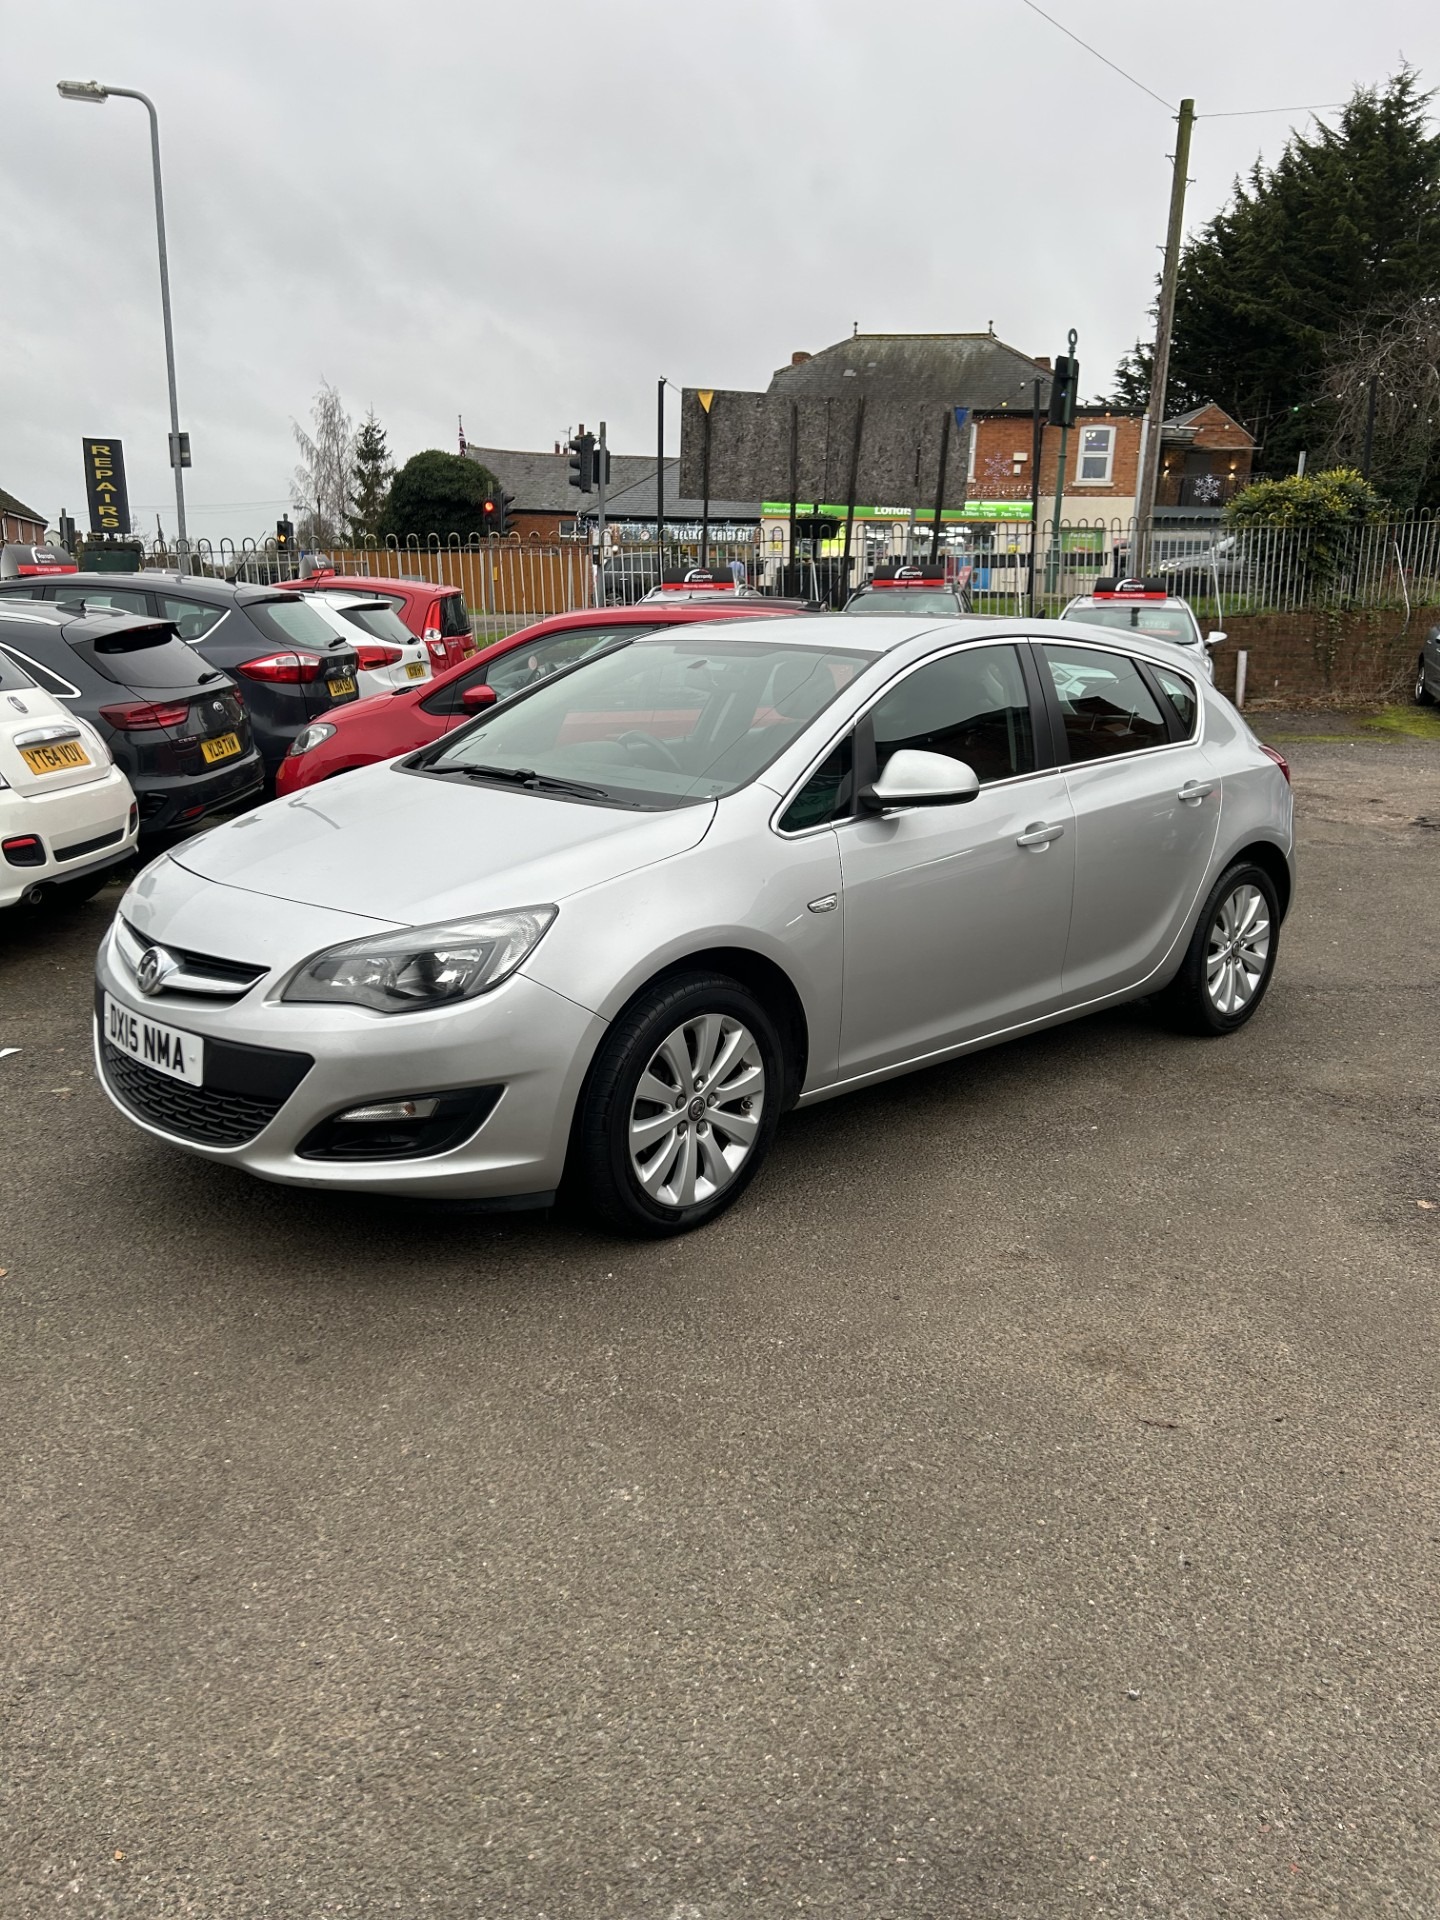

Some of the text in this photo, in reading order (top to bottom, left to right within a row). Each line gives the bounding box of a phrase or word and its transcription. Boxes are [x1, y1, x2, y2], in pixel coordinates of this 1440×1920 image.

[92, 445, 119, 528] REPAIRS
[26, 748, 62, 769] YT64
[110, 1002, 185, 1074] DX15 NMA
